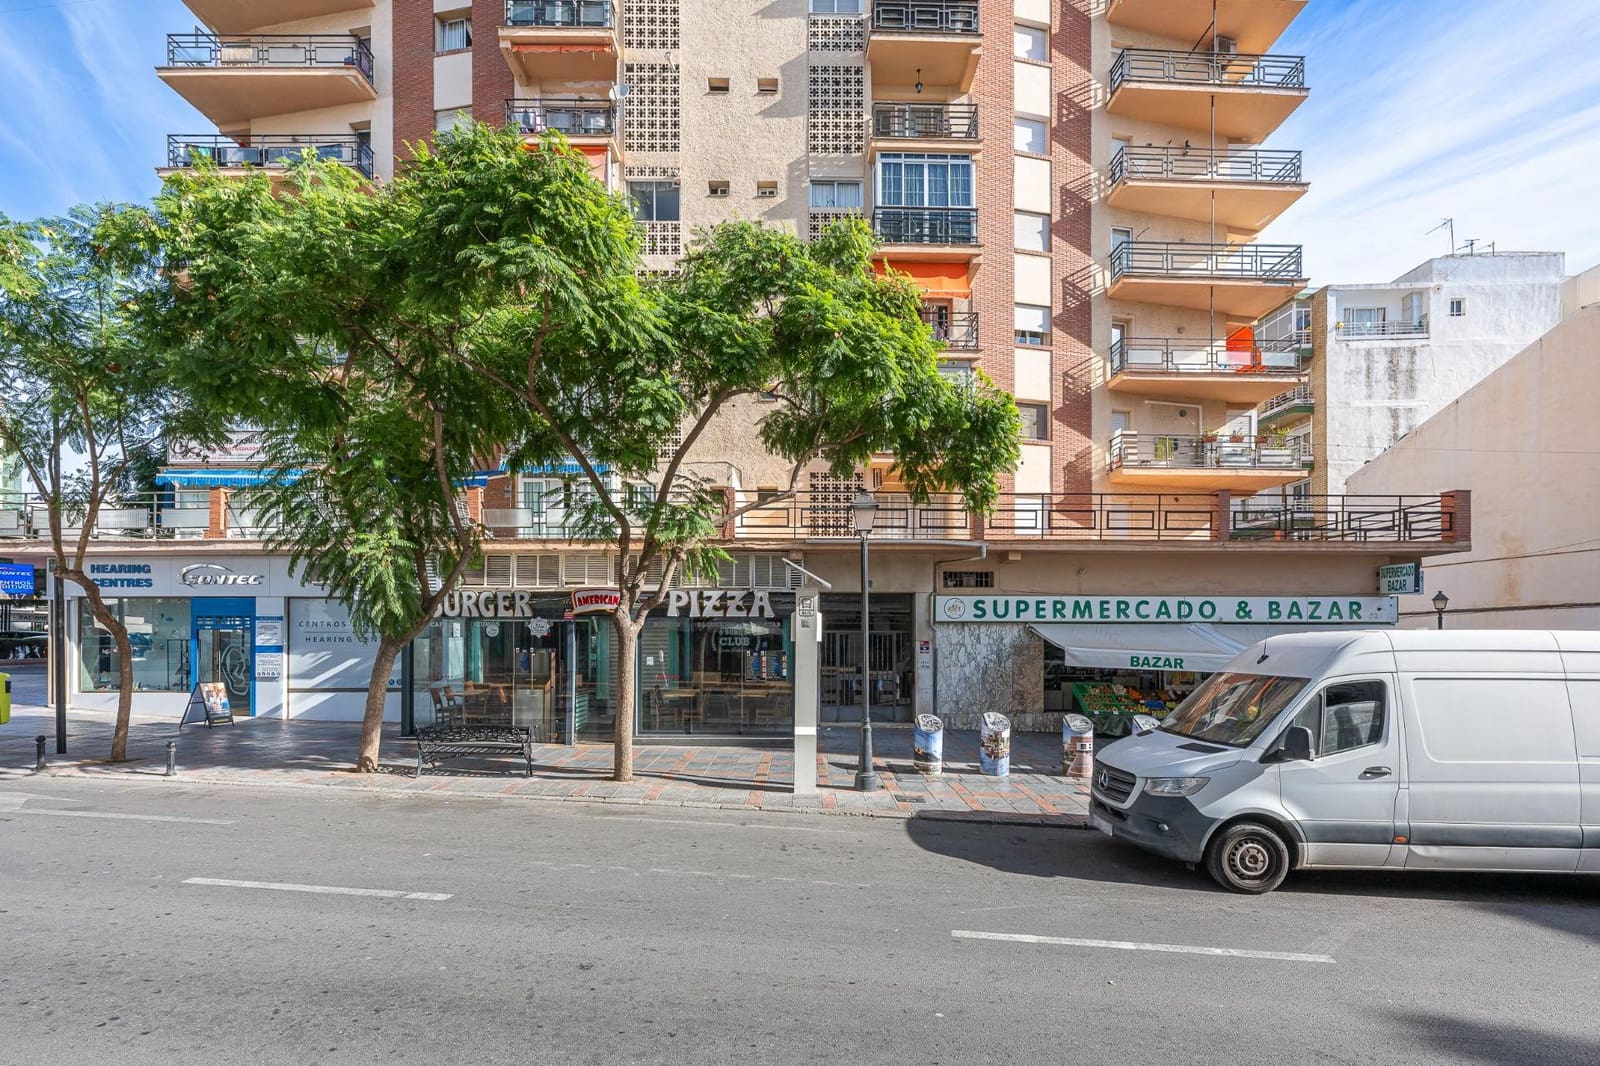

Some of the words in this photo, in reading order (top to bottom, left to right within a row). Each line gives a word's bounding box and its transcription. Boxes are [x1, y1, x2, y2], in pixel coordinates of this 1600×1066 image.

[90, 564, 152, 573] HEARING
[1387, 579, 1407, 592] BAZAR
[667, 590, 775, 618] PIZZA
[973, 600, 1217, 620] SUPERMERCADO
[1236, 600, 1253, 620] &
[1268, 600, 1363, 620] BAZAR
[298, 620, 347, 628] CENTROS
[305, 635, 353, 643] HEARING
[719, 637, 751, 646] CLUB
[1130, 655, 1185, 669] BAZAR
